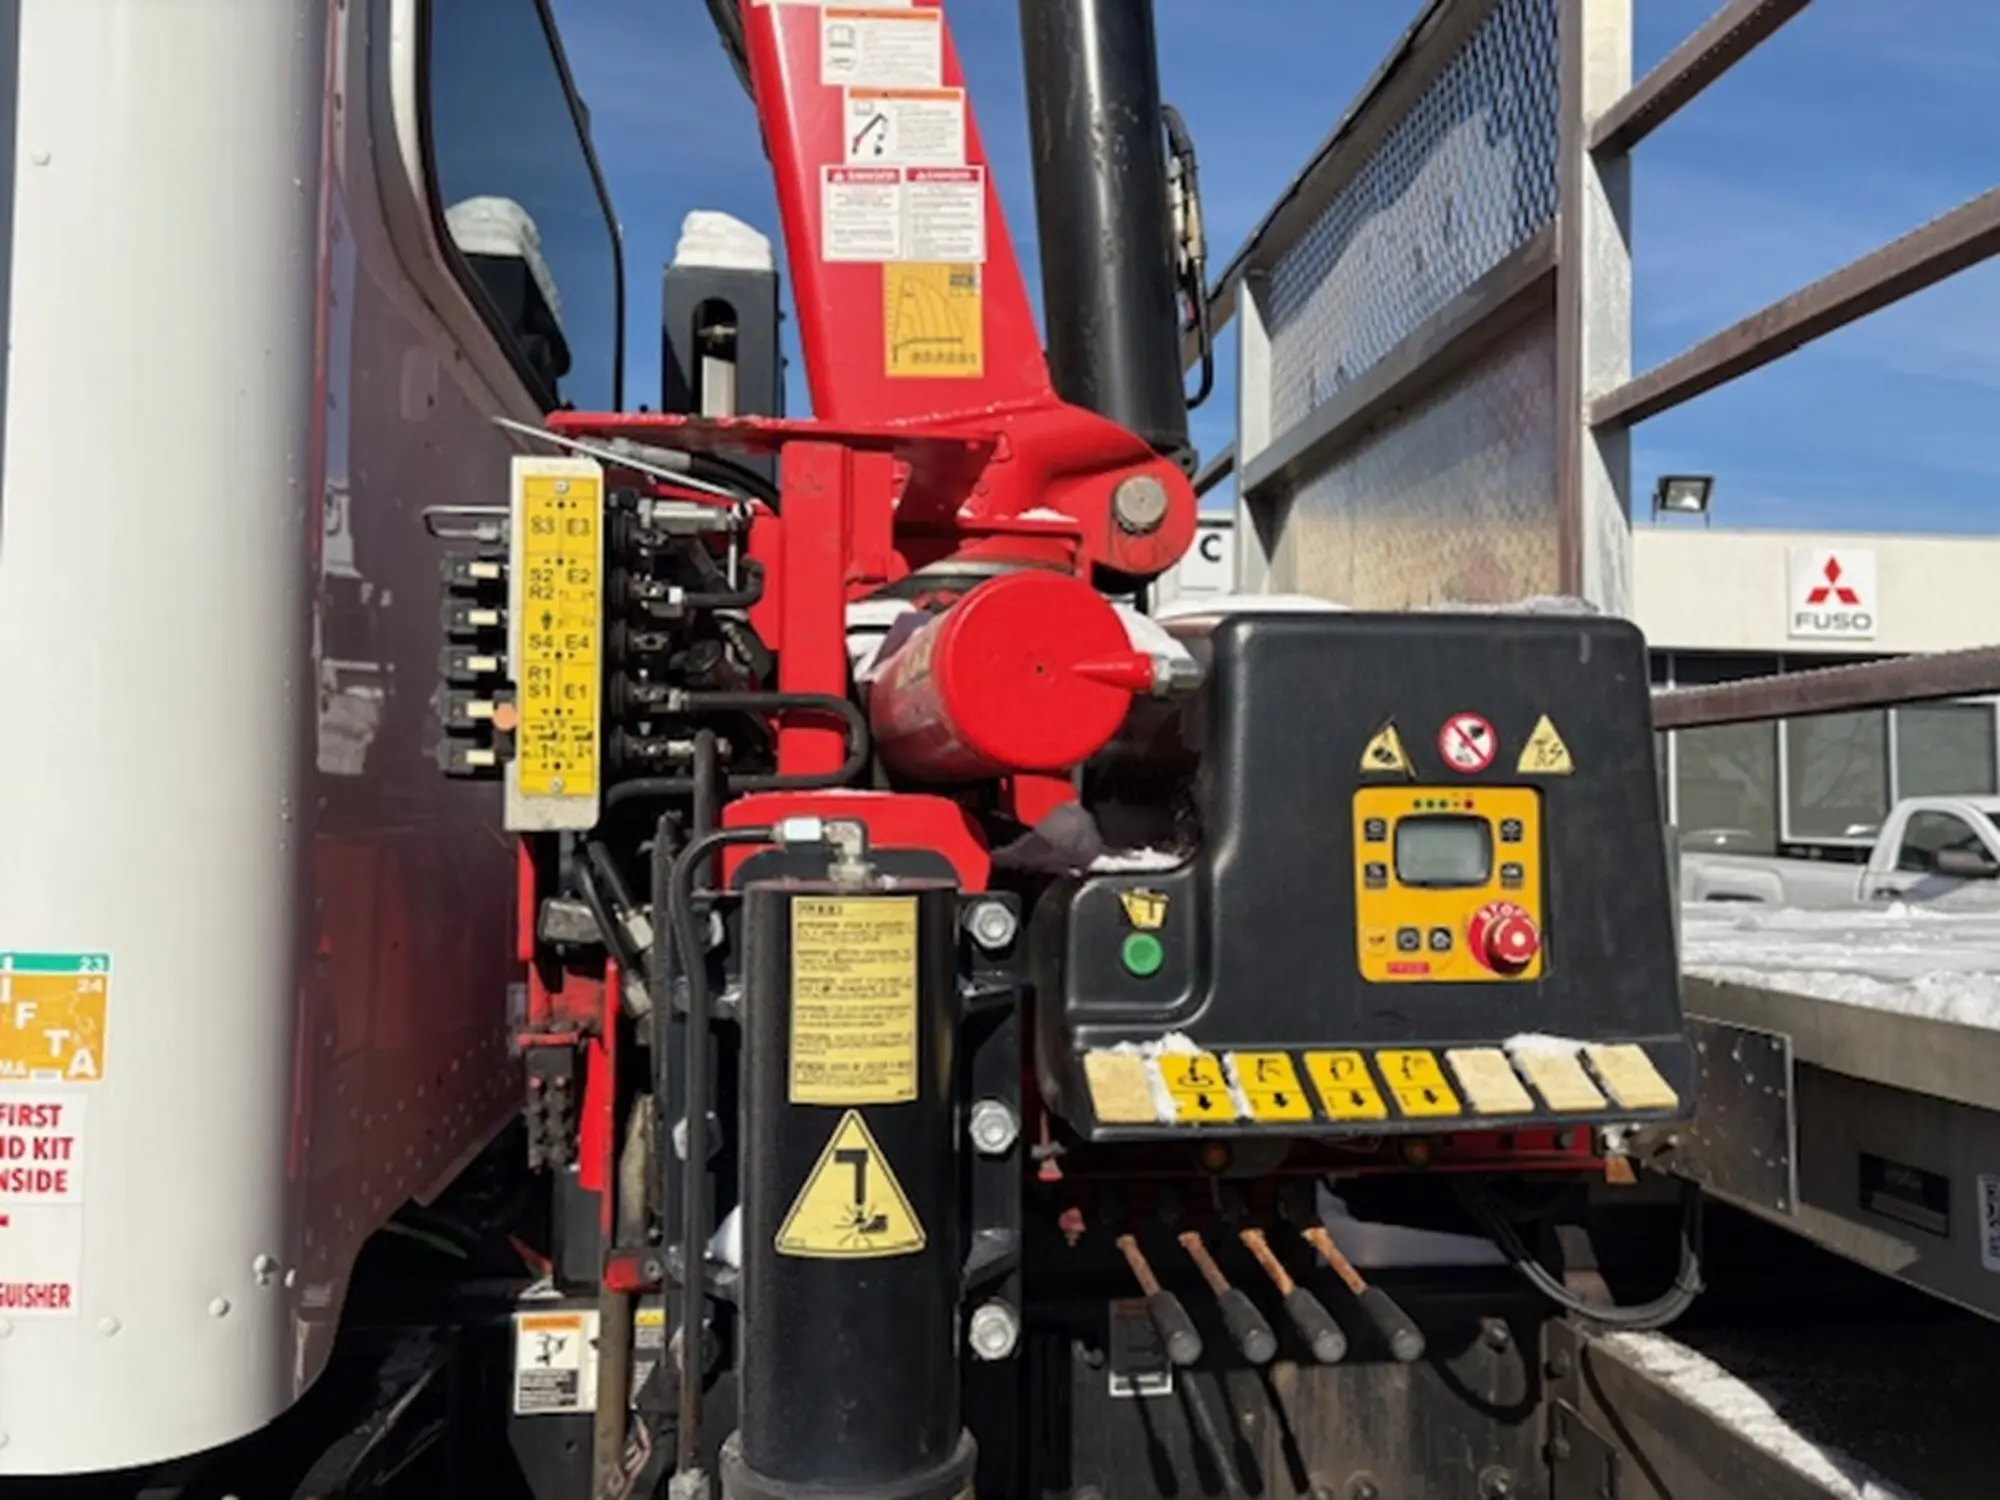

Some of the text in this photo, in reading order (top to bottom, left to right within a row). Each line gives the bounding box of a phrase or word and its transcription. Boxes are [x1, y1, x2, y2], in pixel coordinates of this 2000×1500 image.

[531, 515, 555, 535] S3
[566, 517, 591, 536] E3
[530, 567, 554, 582] S2
[567, 568, 591, 585] E2
[529, 584, 554, 600] R2
[1795, 612, 1873, 631] FUSO
[528, 633, 554, 649] S4
[565, 633, 590, 650] E4
[528, 666, 551, 680] R1
[528, 683, 551, 699] S1
[564, 683, 587, 700] E1
[33, 1136, 75, 1161] KIT
